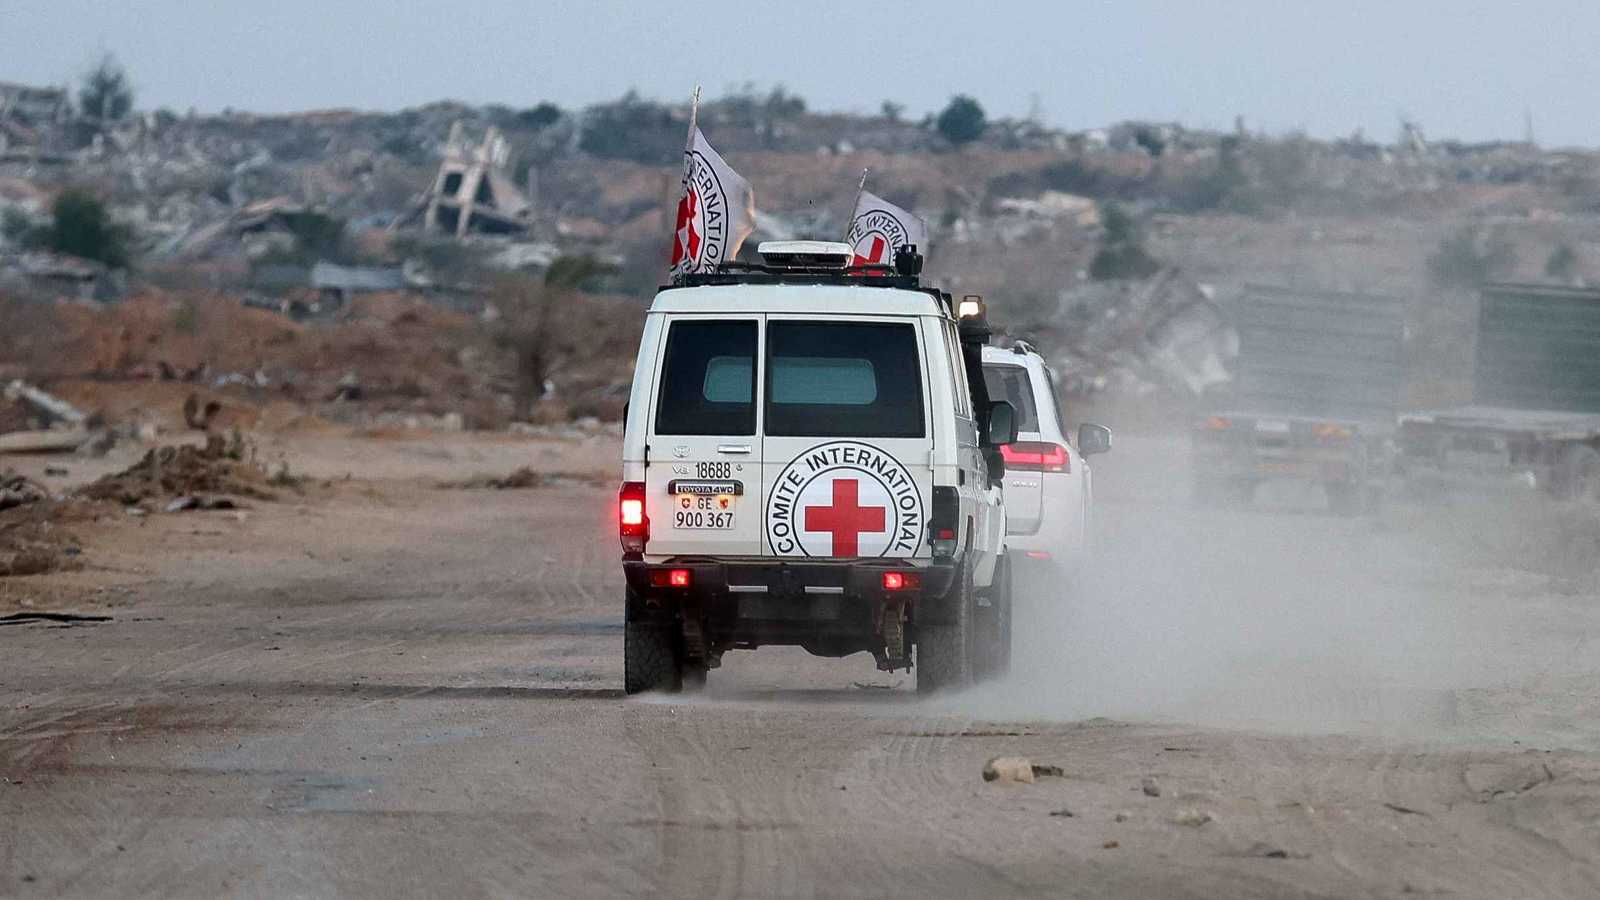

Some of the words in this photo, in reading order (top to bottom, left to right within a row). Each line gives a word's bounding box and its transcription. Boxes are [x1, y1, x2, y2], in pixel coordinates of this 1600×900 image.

[695, 461, 731, 479] 18688
[678, 485, 712, 493] TOYOTA
[713, 485, 734, 493] 4WD
[697, 497, 713, 510] GE
[773, 469, 805, 554] COMITE
[806, 447, 919, 553] INTERNATIONAL
[676, 511, 703, 527] 900
[707, 512, 733, 528] 367
